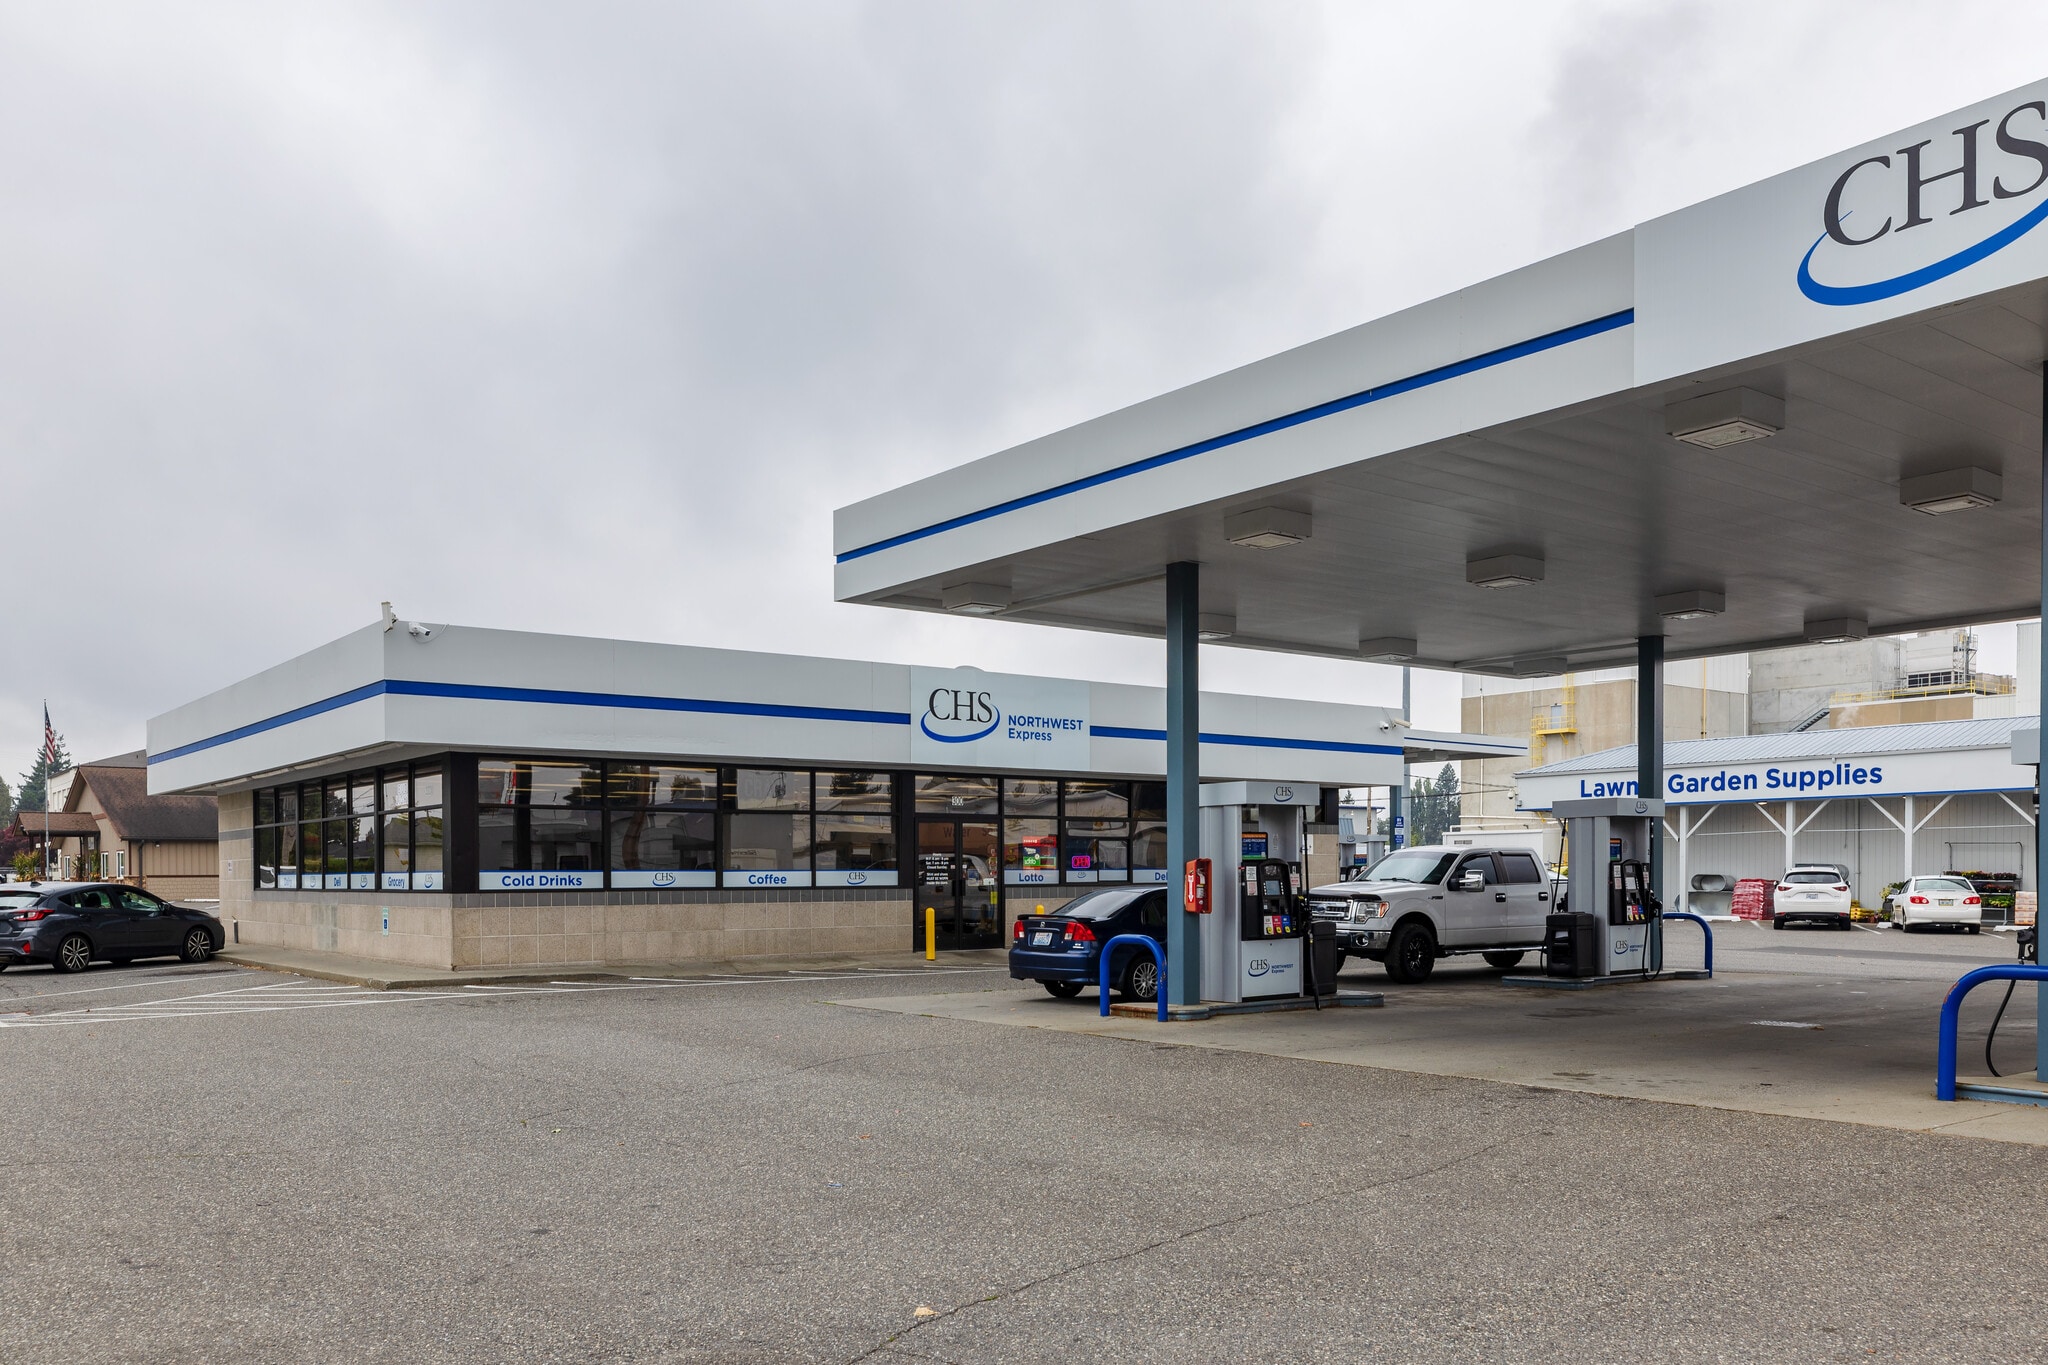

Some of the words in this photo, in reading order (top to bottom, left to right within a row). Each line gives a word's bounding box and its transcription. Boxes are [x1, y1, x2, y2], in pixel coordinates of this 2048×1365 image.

[1824, 101, 2048, 245] CHS
[929, 688, 993, 723] CHS
[1008, 715, 1084, 731] NORTHWEST
[1008, 728, 1053, 742] Express
[1580, 779, 1639, 799] Lawn
[1667, 770, 1758, 794] Garden
[1765, 763, 1883, 792] Supplies
[1276, 786, 1292, 796] CHS
[1073, 857, 1090, 867] OPEN
[501, 875, 535, 887] Cold
[539, 875, 583, 887] Drinks
[654, 872, 674, 882] CHS
[748, 874, 787, 885] Coffee
[848, 872, 866, 880] CHS
[1018, 873, 1044, 882] Lotto
[333, 877, 342, 887] Deli
[387, 876, 405, 889] Grocery
[1250, 959, 1268, 970] CHS
